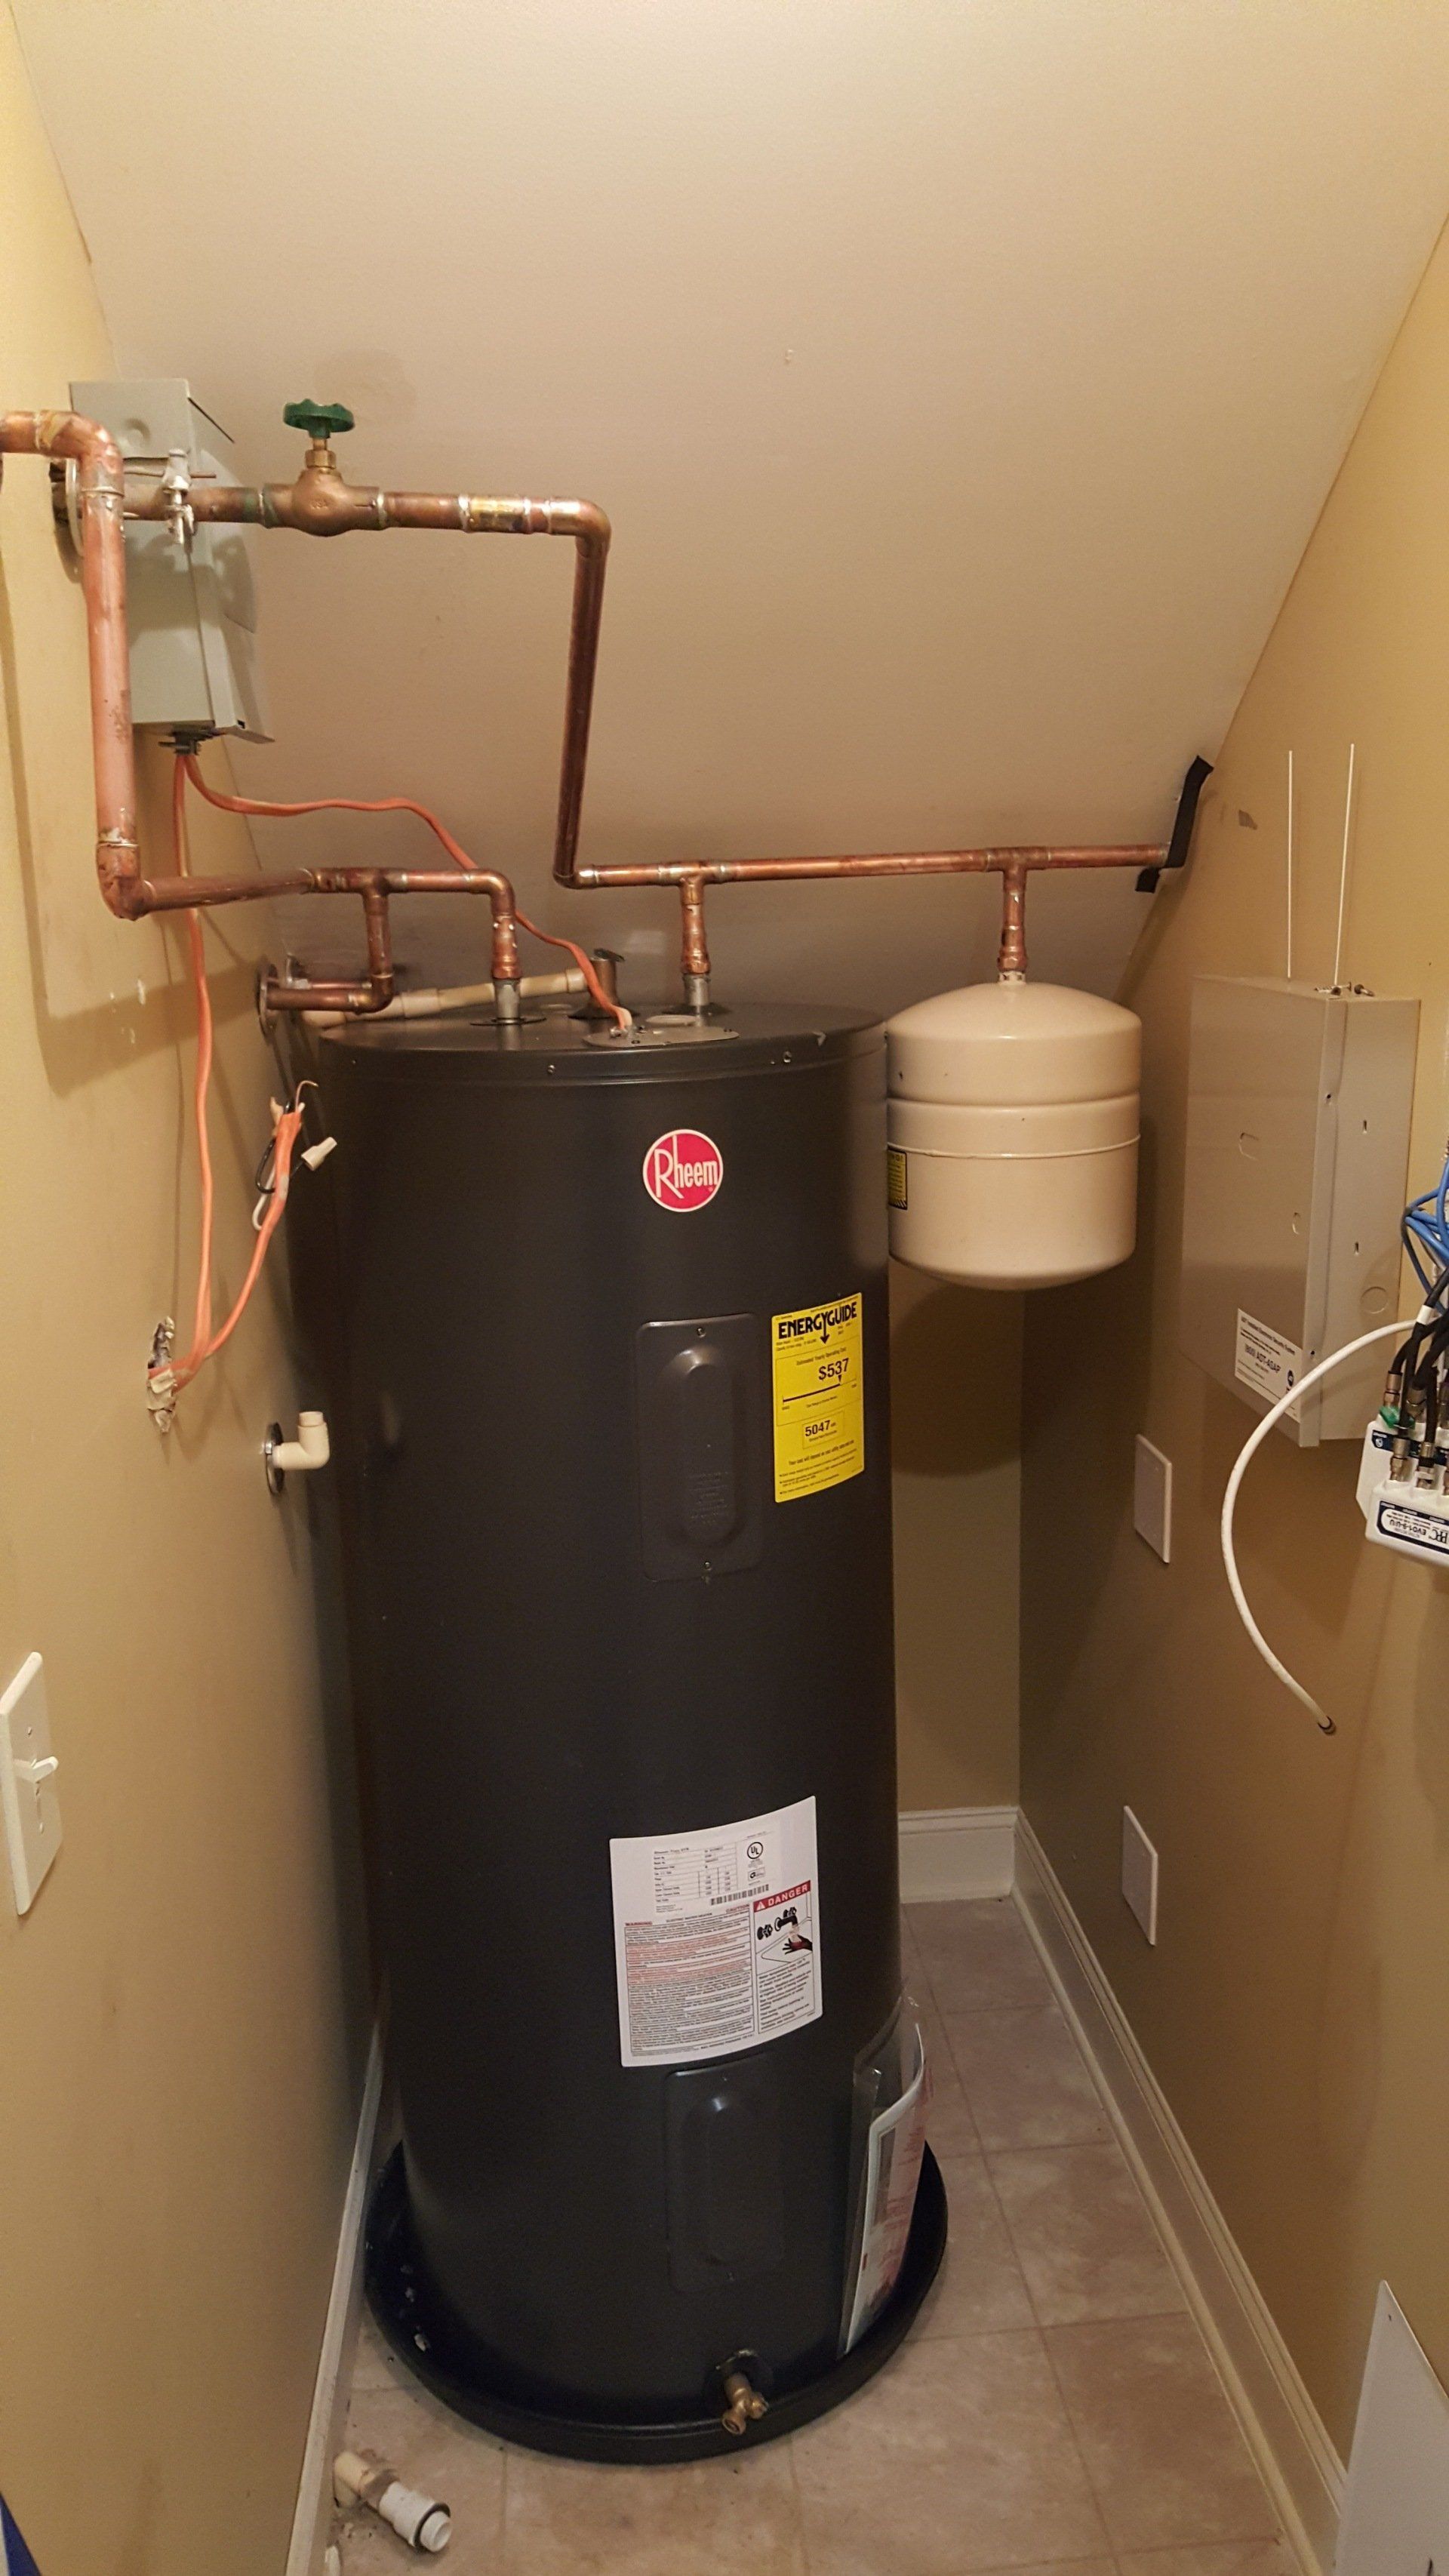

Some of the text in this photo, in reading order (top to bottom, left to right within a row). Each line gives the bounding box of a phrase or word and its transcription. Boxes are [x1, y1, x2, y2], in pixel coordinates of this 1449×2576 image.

[654, 1134, 718, 1199] Rheem
[778, 1301, 857, 1340] ENERGYGUIDE
[818, 1357, 849, 1381] $537
[805, 1420, 831, 1437] 5047
[1429, 1528, 1448, 1544] PPC
[768, 1883, 808, 1907] DANGER
